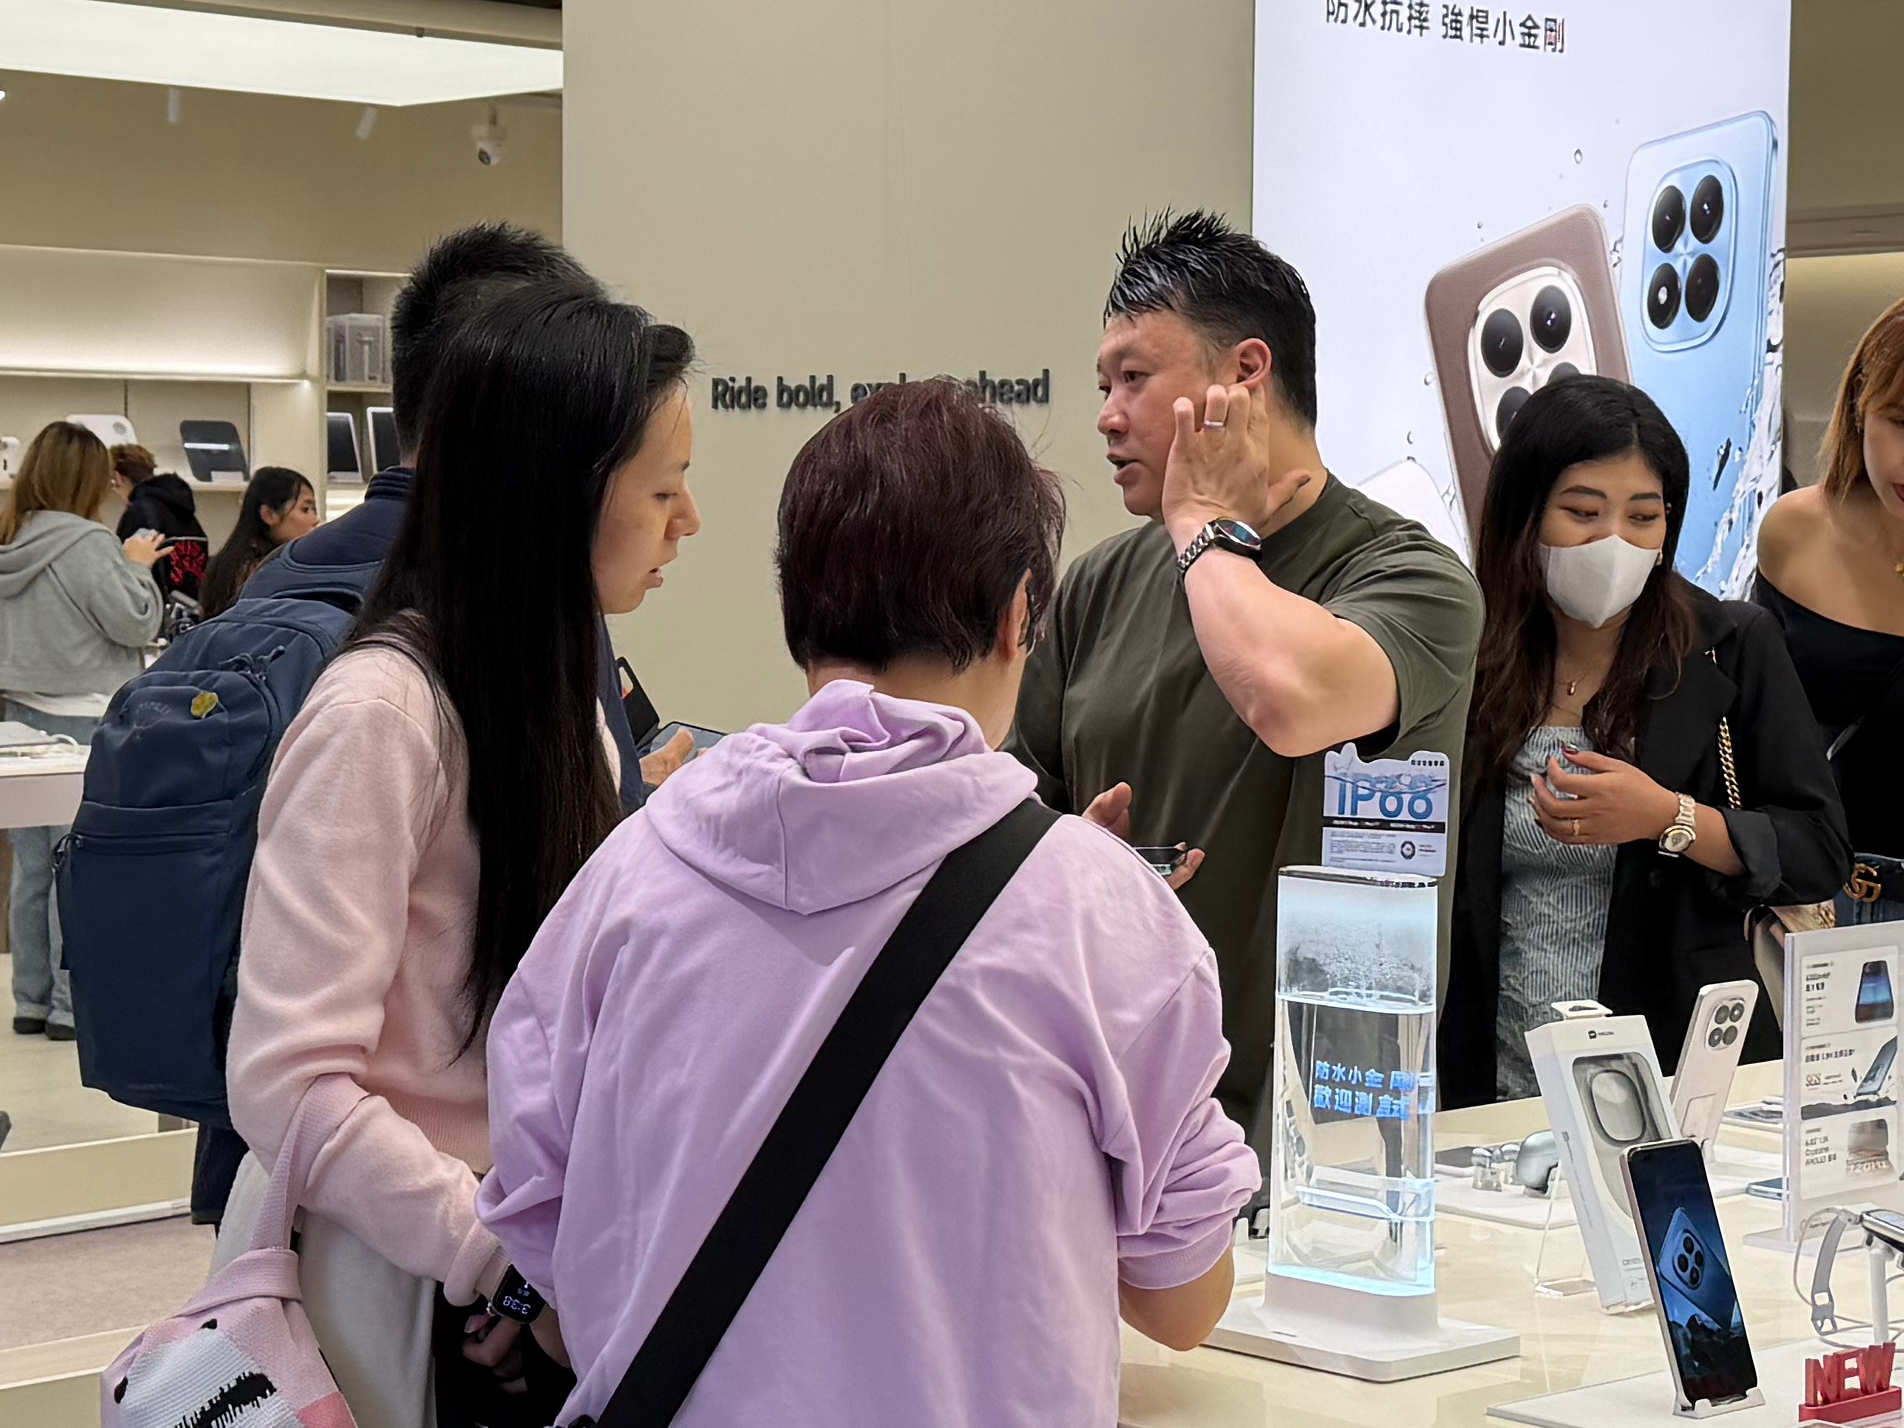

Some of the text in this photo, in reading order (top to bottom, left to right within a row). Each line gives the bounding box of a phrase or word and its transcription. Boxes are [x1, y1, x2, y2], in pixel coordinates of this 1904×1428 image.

[1440, 2, 1566, 53] 強悍小金剛
[711, 376, 768, 410] Ride
[776, 374, 842, 413] bold,
[1804, 1341, 1897, 1407] NEW
